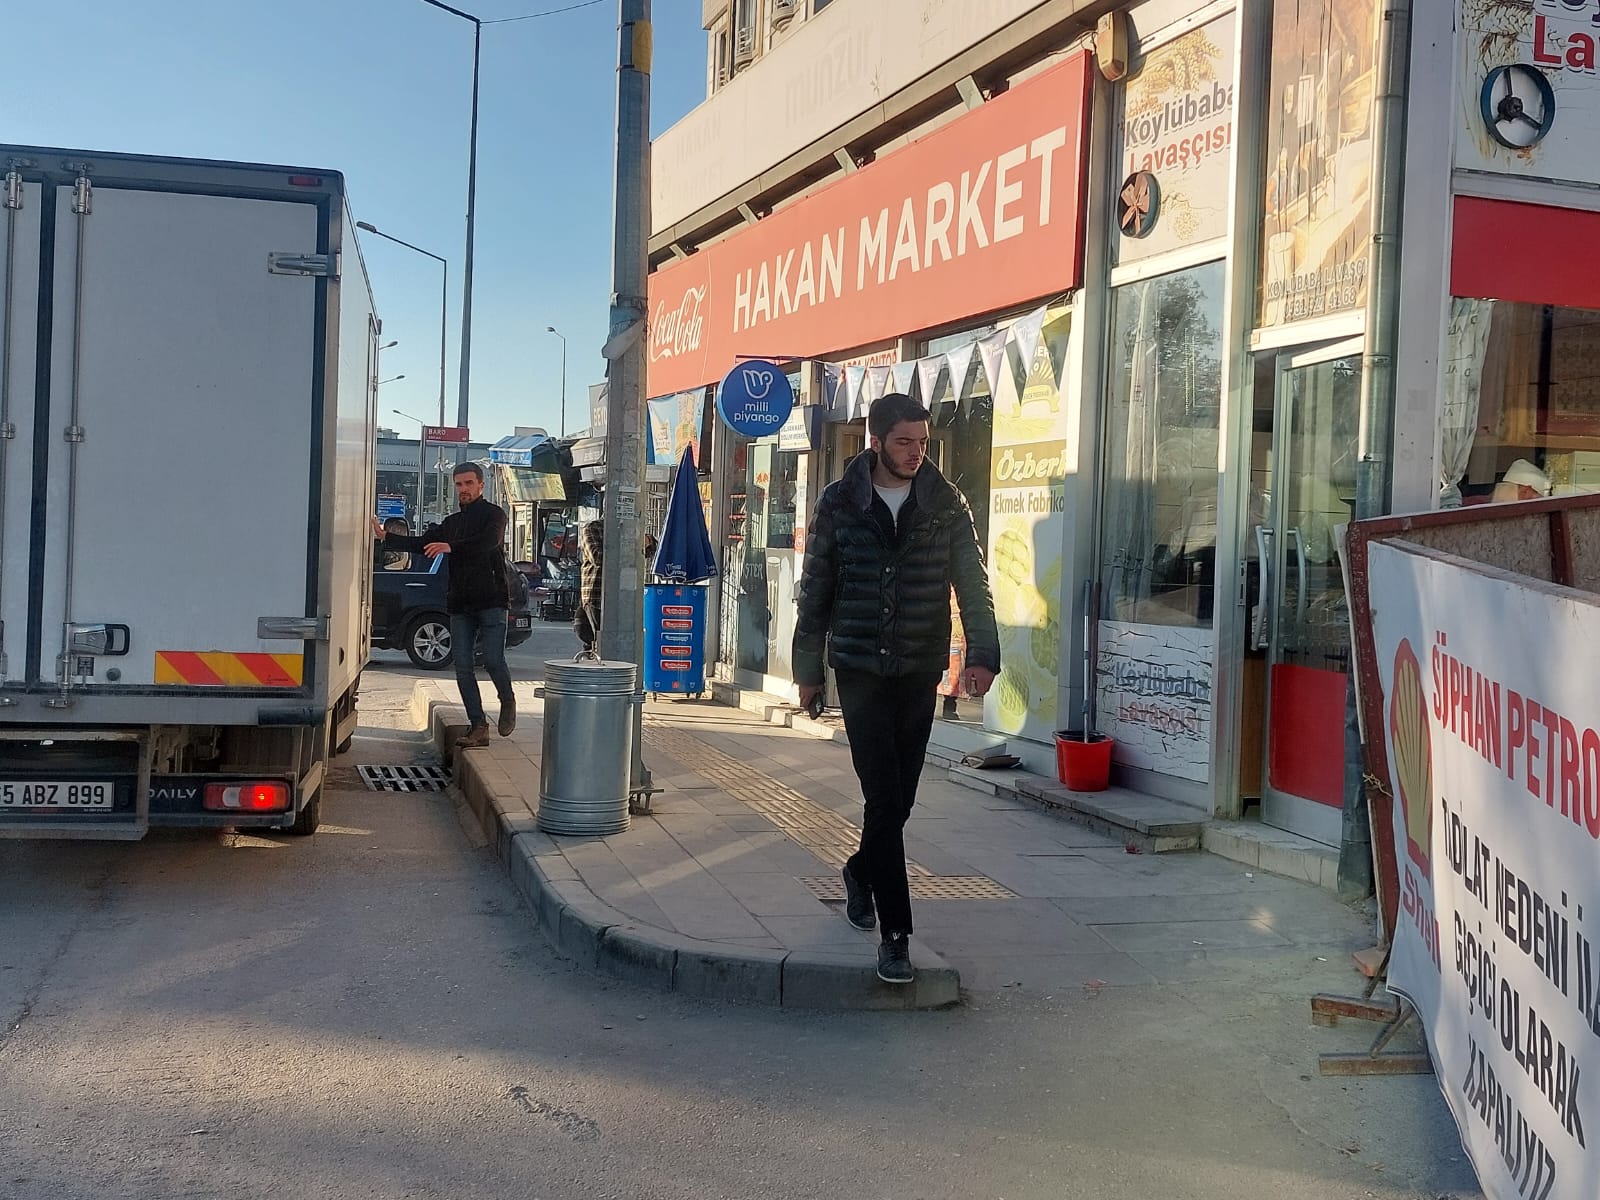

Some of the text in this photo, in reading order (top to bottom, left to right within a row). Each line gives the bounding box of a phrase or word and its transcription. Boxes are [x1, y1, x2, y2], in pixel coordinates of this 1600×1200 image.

[1534, 15, 1600, 70] La
[733, 126, 1067, 334] HAKAN MARKET
[649, 284, 707, 362] Coca-Cola
[734, 410, 779, 424] piyango
[744, 402, 769, 411] milli
[994, 492, 1024, 513] Ekmek
[22, 785, 58, 804] ABZ
[69, 785, 105, 805] 899
[1403, 864, 1441, 975] Shell
[1495, 856, 1568, 998] NEDENİ
[1500, 977, 1585, 1150] OLARAK
